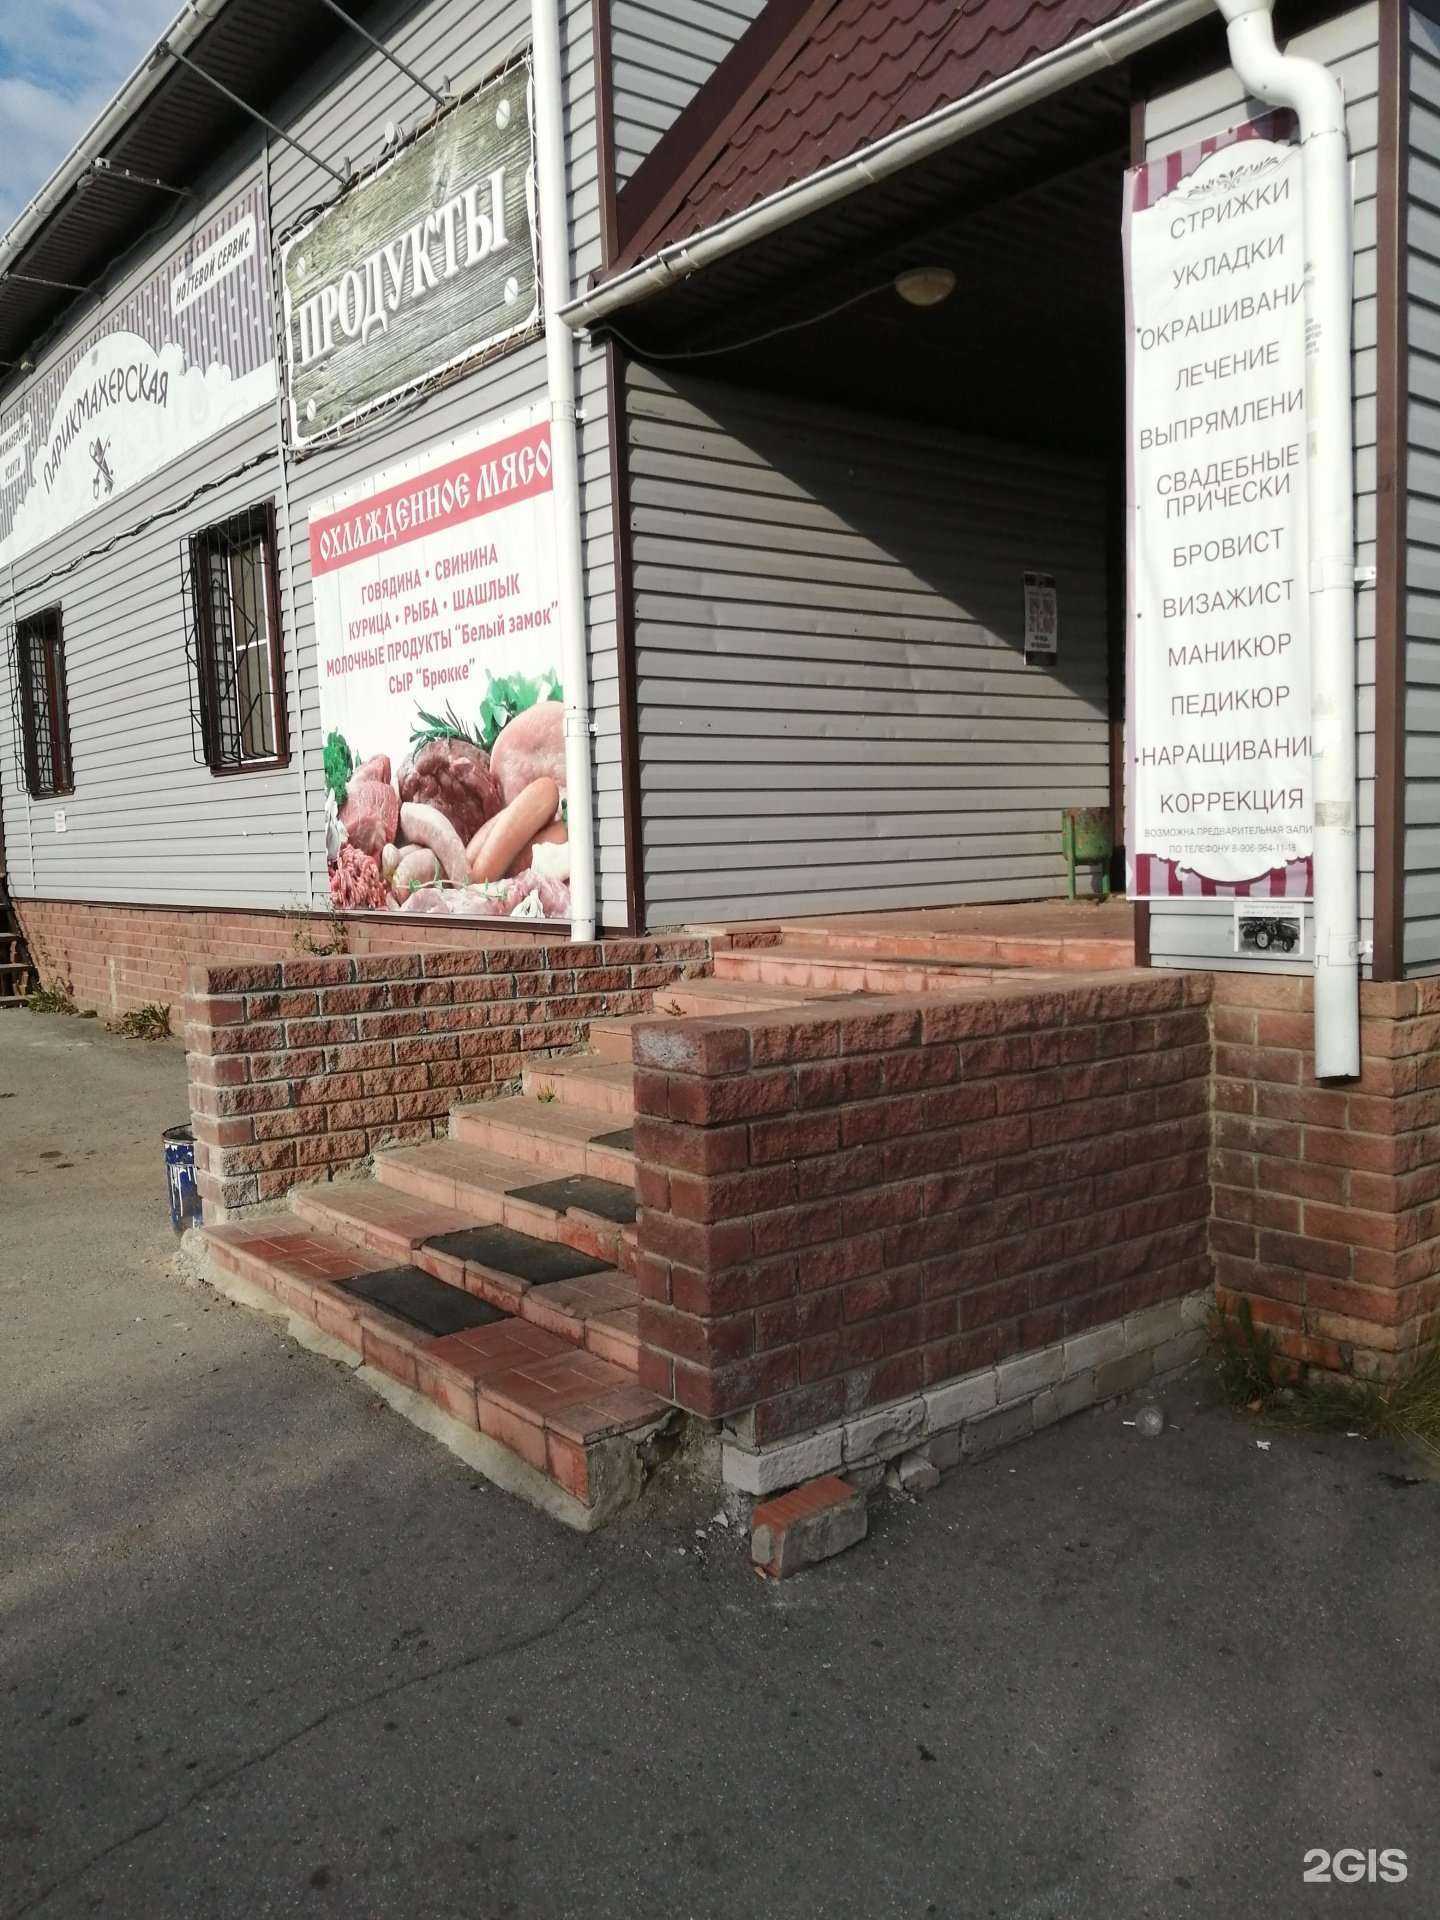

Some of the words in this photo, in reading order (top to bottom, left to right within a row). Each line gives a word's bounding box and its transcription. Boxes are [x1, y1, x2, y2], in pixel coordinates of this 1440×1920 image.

[1170, 177, 1290, 240] СТРИЖКИ
[217, 228, 250, 271] СЕРВИС
[299, 167, 509, 368] ПРОДУКТЫ
[1172, 233, 1285, 290] УКЛАДКИ
[1140, 281, 1305, 351] ОКРАШИВАНИ
[1175, 341, 1280, 391] ЛЕЧЕНИЕ
[43, 362, 168, 494] ПАРИКМАХЕРСКАЯ
[1140, 388, 1303, 450] ВЫПРЯМЛЕНИ
[1156, 443, 1300, 496] СВАДЕБНЫЕ
[319, 472, 471, 561] ОХЛАЖДЕННОЕ
[476, 439, 551, 502] МЯСО
[1166, 474, 1291, 519] ПРИЧЕСКИ
[1173, 528, 1285, 568] БРОВИСТ
[361, 569, 422, 605] ГОВЯДИНА
[435, 543, 498, 582] СВИНИНА
[348, 607, 392, 641] КУРИЦА
[403, 598, 439, 626] РЫБА
[453, 574, 521, 612] ШАШЛЫК
[1163, 579, 1295, 619] ВИЗАЖИСТ
[326, 646, 385, 677] МОЛОЧНЫЕ
[387, 629, 452, 662] ПРОДУКТЫ
[1168, 633, 1292, 668] МАНИКЮР
[389, 672, 414, 695] СЫР
[1171, 685, 1290, 718] ПЕДИКЮР
[1142, 736, 1312, 767] НАРАЩИВАНИ
[1160, 788, 1303, 816] КОРРЕКЦИЯ
[1144, 828, 1195, 838] ВОЗМОЖНА
[1286, 824, 1312, 835] ЗАПИ
[1169, 844, 1182, 854] ПО
[1184, 844, 1229, 854] ТЕЛЕФОНУ
